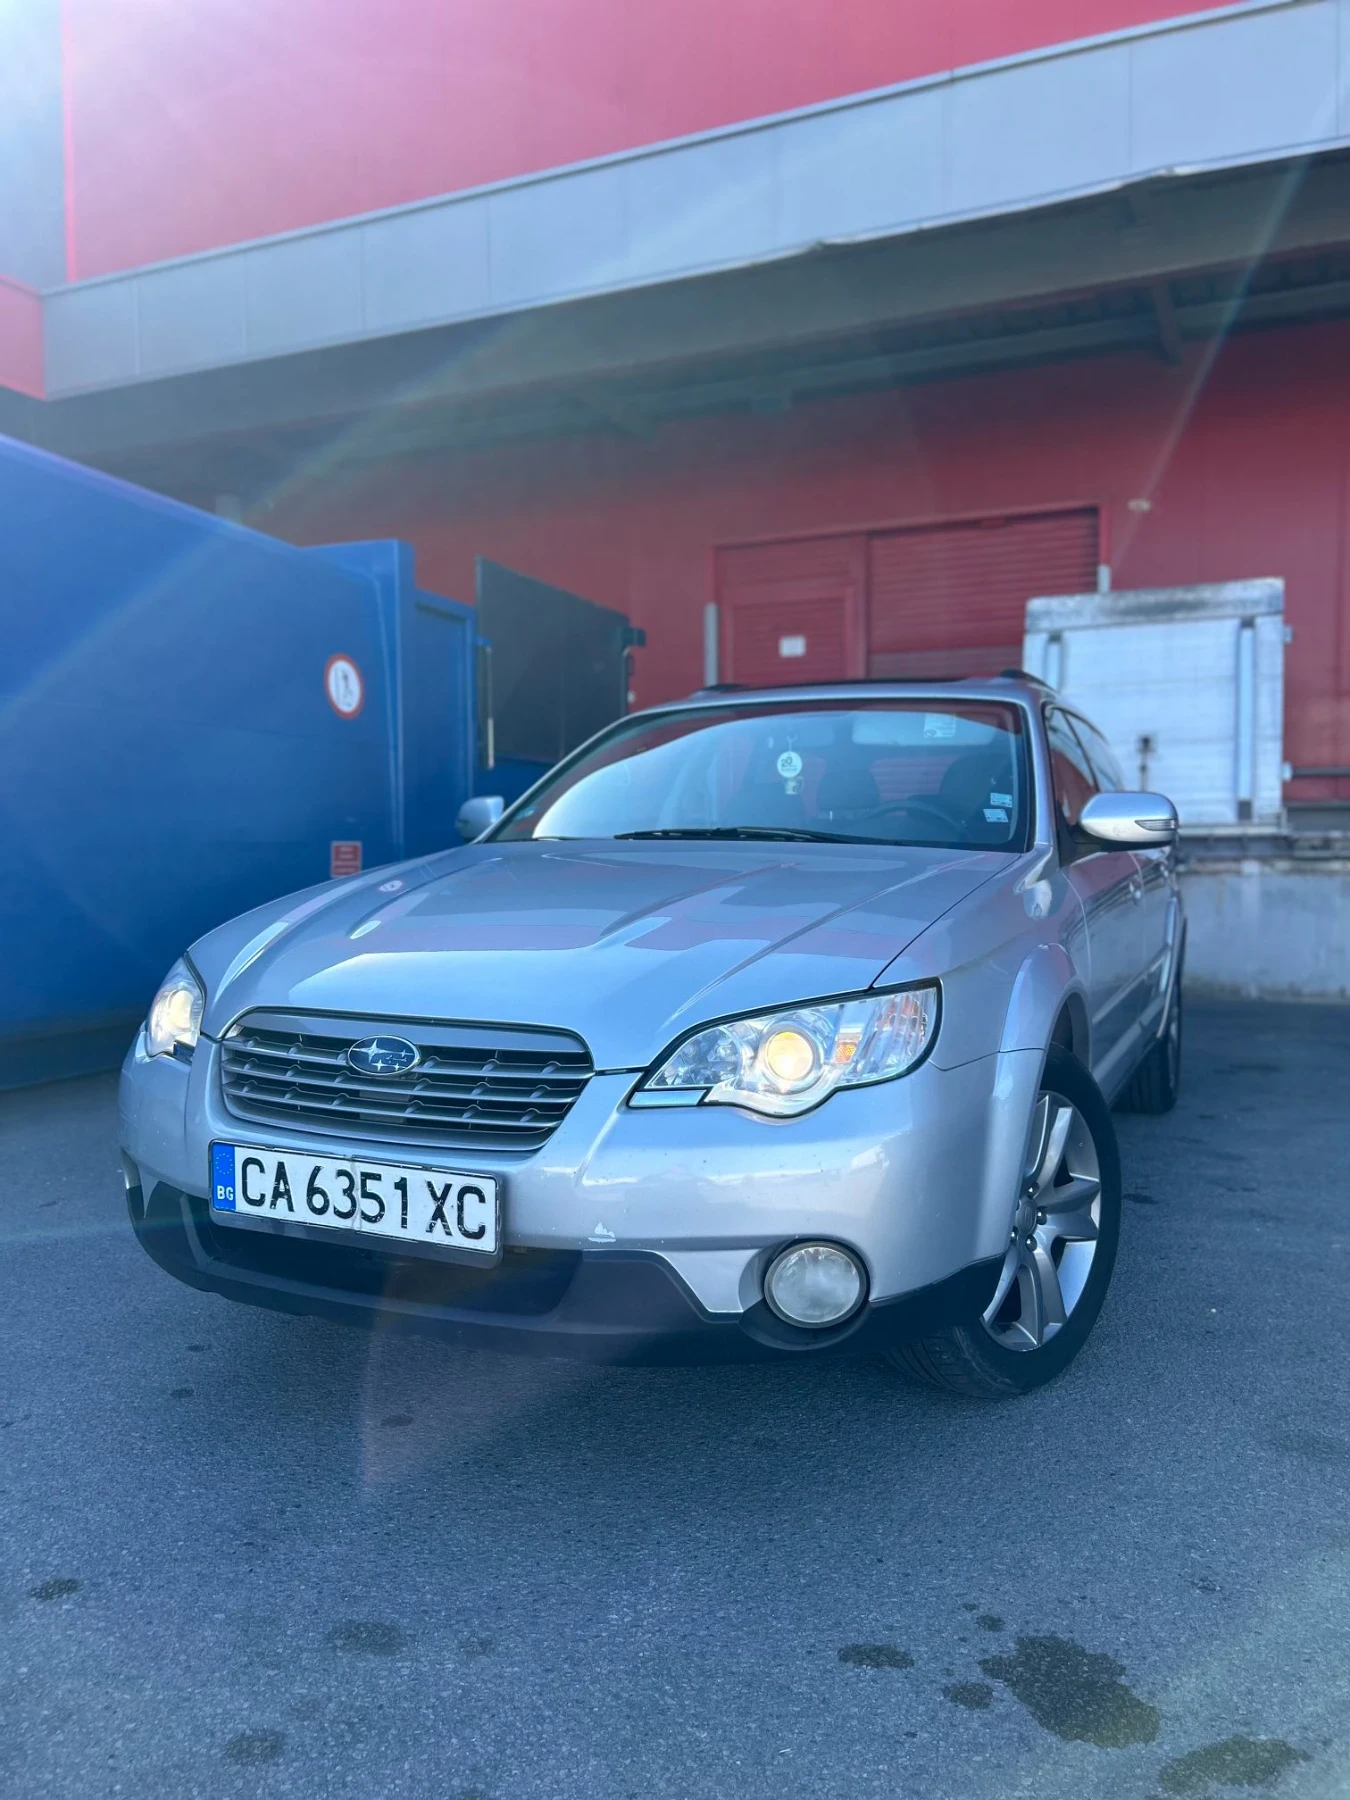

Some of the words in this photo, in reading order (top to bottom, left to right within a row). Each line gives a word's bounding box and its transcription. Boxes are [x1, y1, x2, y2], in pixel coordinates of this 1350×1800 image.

[217, 1185, 234, 1201] BG
[241, 1156, 295, 1212] CA
[306, 1165, 409, 1229] 6351
[425, 1179, 486, 1240] XC
